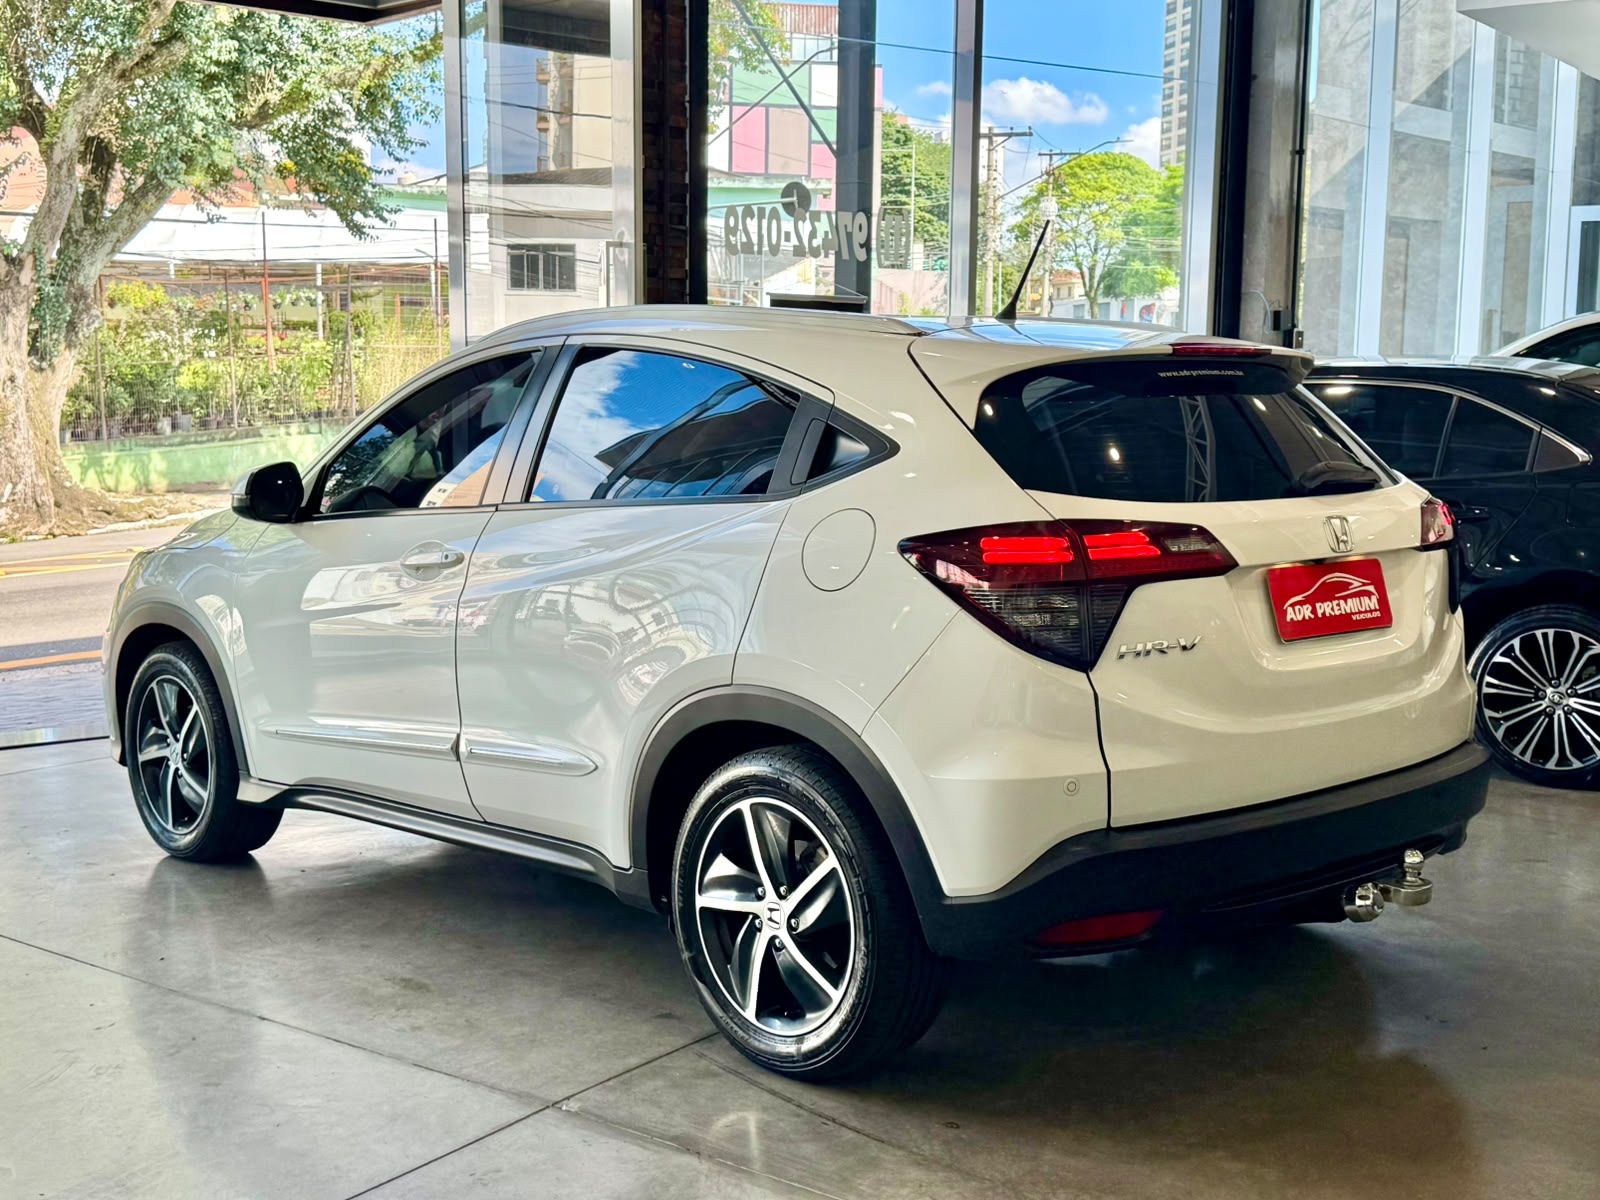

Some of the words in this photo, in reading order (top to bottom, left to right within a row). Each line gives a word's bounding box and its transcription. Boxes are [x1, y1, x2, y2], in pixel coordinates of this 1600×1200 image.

[1286, 603, 1315, 622] ADR
[1317, 595, 1380, 618] PREMIUM
[1117, 635, 1202, 660] HR-V
